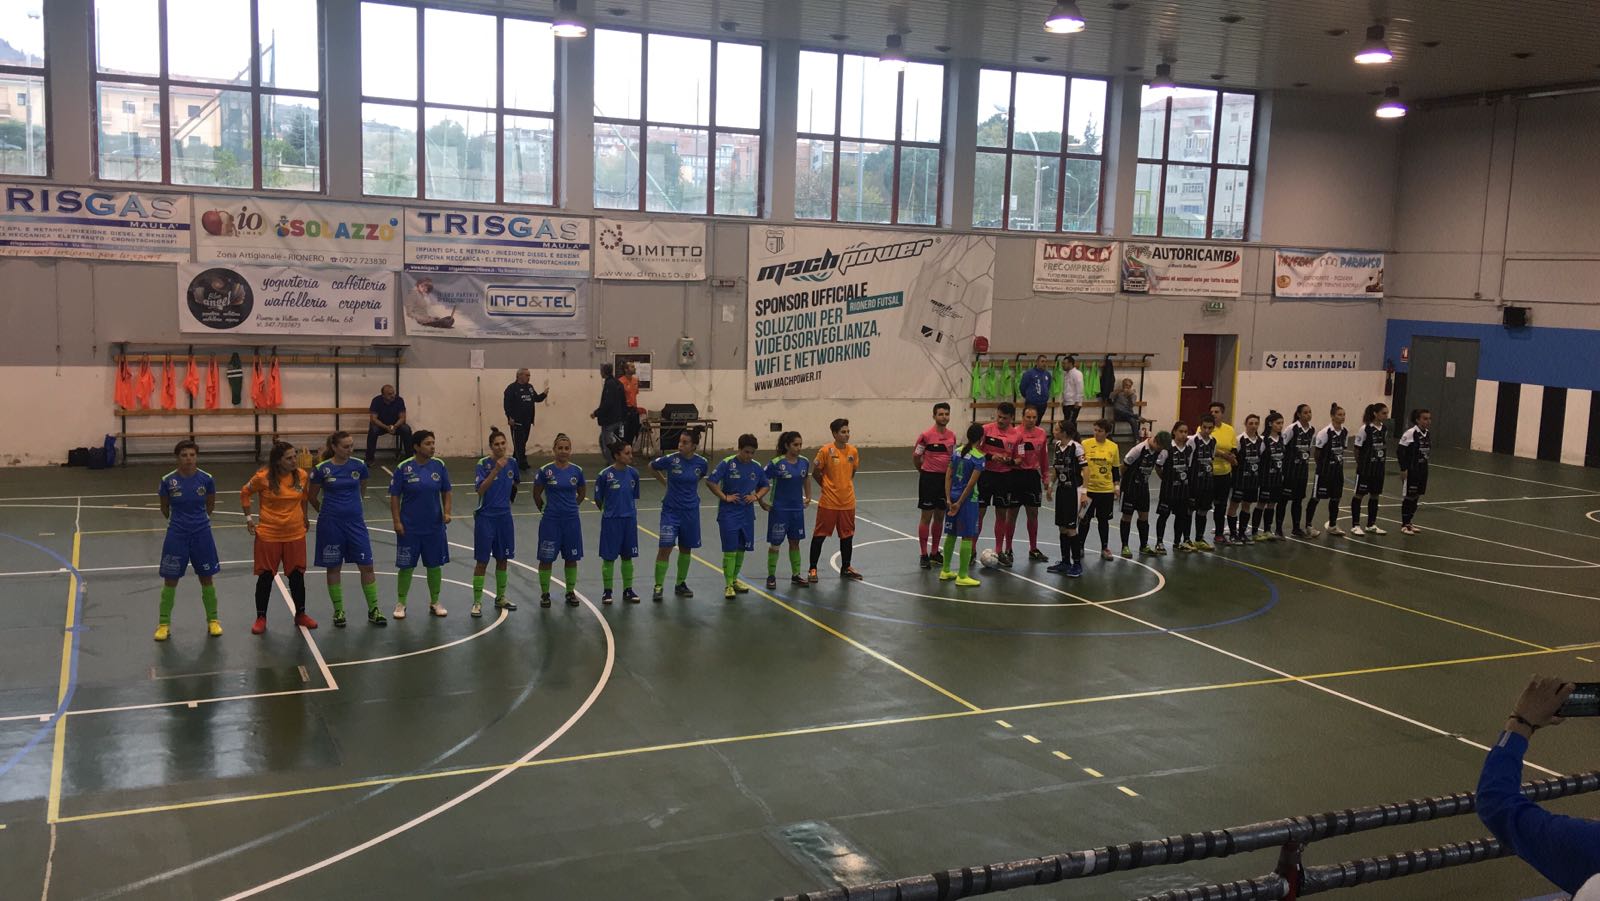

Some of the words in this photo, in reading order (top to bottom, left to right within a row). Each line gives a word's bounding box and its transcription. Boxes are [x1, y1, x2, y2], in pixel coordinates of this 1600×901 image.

[7, 187, 178, 220] RISGAS
[417, 212, 582, 241] TRISGAS
[216, 250, 237, 258] Zona
[239, 251, 282, 260] Artigianale
[288, 253, 325, 262] RIONERO
[622, 244, 703, 257] DIMITTO
[1044, 245, 1110, 260] MOSCA
[1152, 246, 1237, 263] AUTORICAMBI
[528, 258, 580, 267] CRONOTACHIGRAFI
[260, 276, 320, 292] yogurteria
[331, 274, 387, 291] caffetteria
[264, 291, 328, 309] waffelleria
[338, 298, 382, 314] creperia
[490, 295, 573, 308] INFO&TEL
[755, 293, 809, 317] SPONSOR
[811, 282, 868, 306] UFFICIALE
[849, 298, 876, 312] RIONERO
[876, 295, 900, 308] FUTSAL
[755, 311, 817, 338] SOLUZIONI
[820, 307, 844, 327] PER
[755, 319, 881, 356] VIDEOSORVEGLIANZA,
[755, 355, 781, 377] WIFI
[783, 353, 791, 371] E
[794, 341, 871, 369] NETWORKING
[1282, 361, 1356, 369] COSTANTINOPOLI
[754, 370, 822, 391] WWW.MACHPOWER.IT
